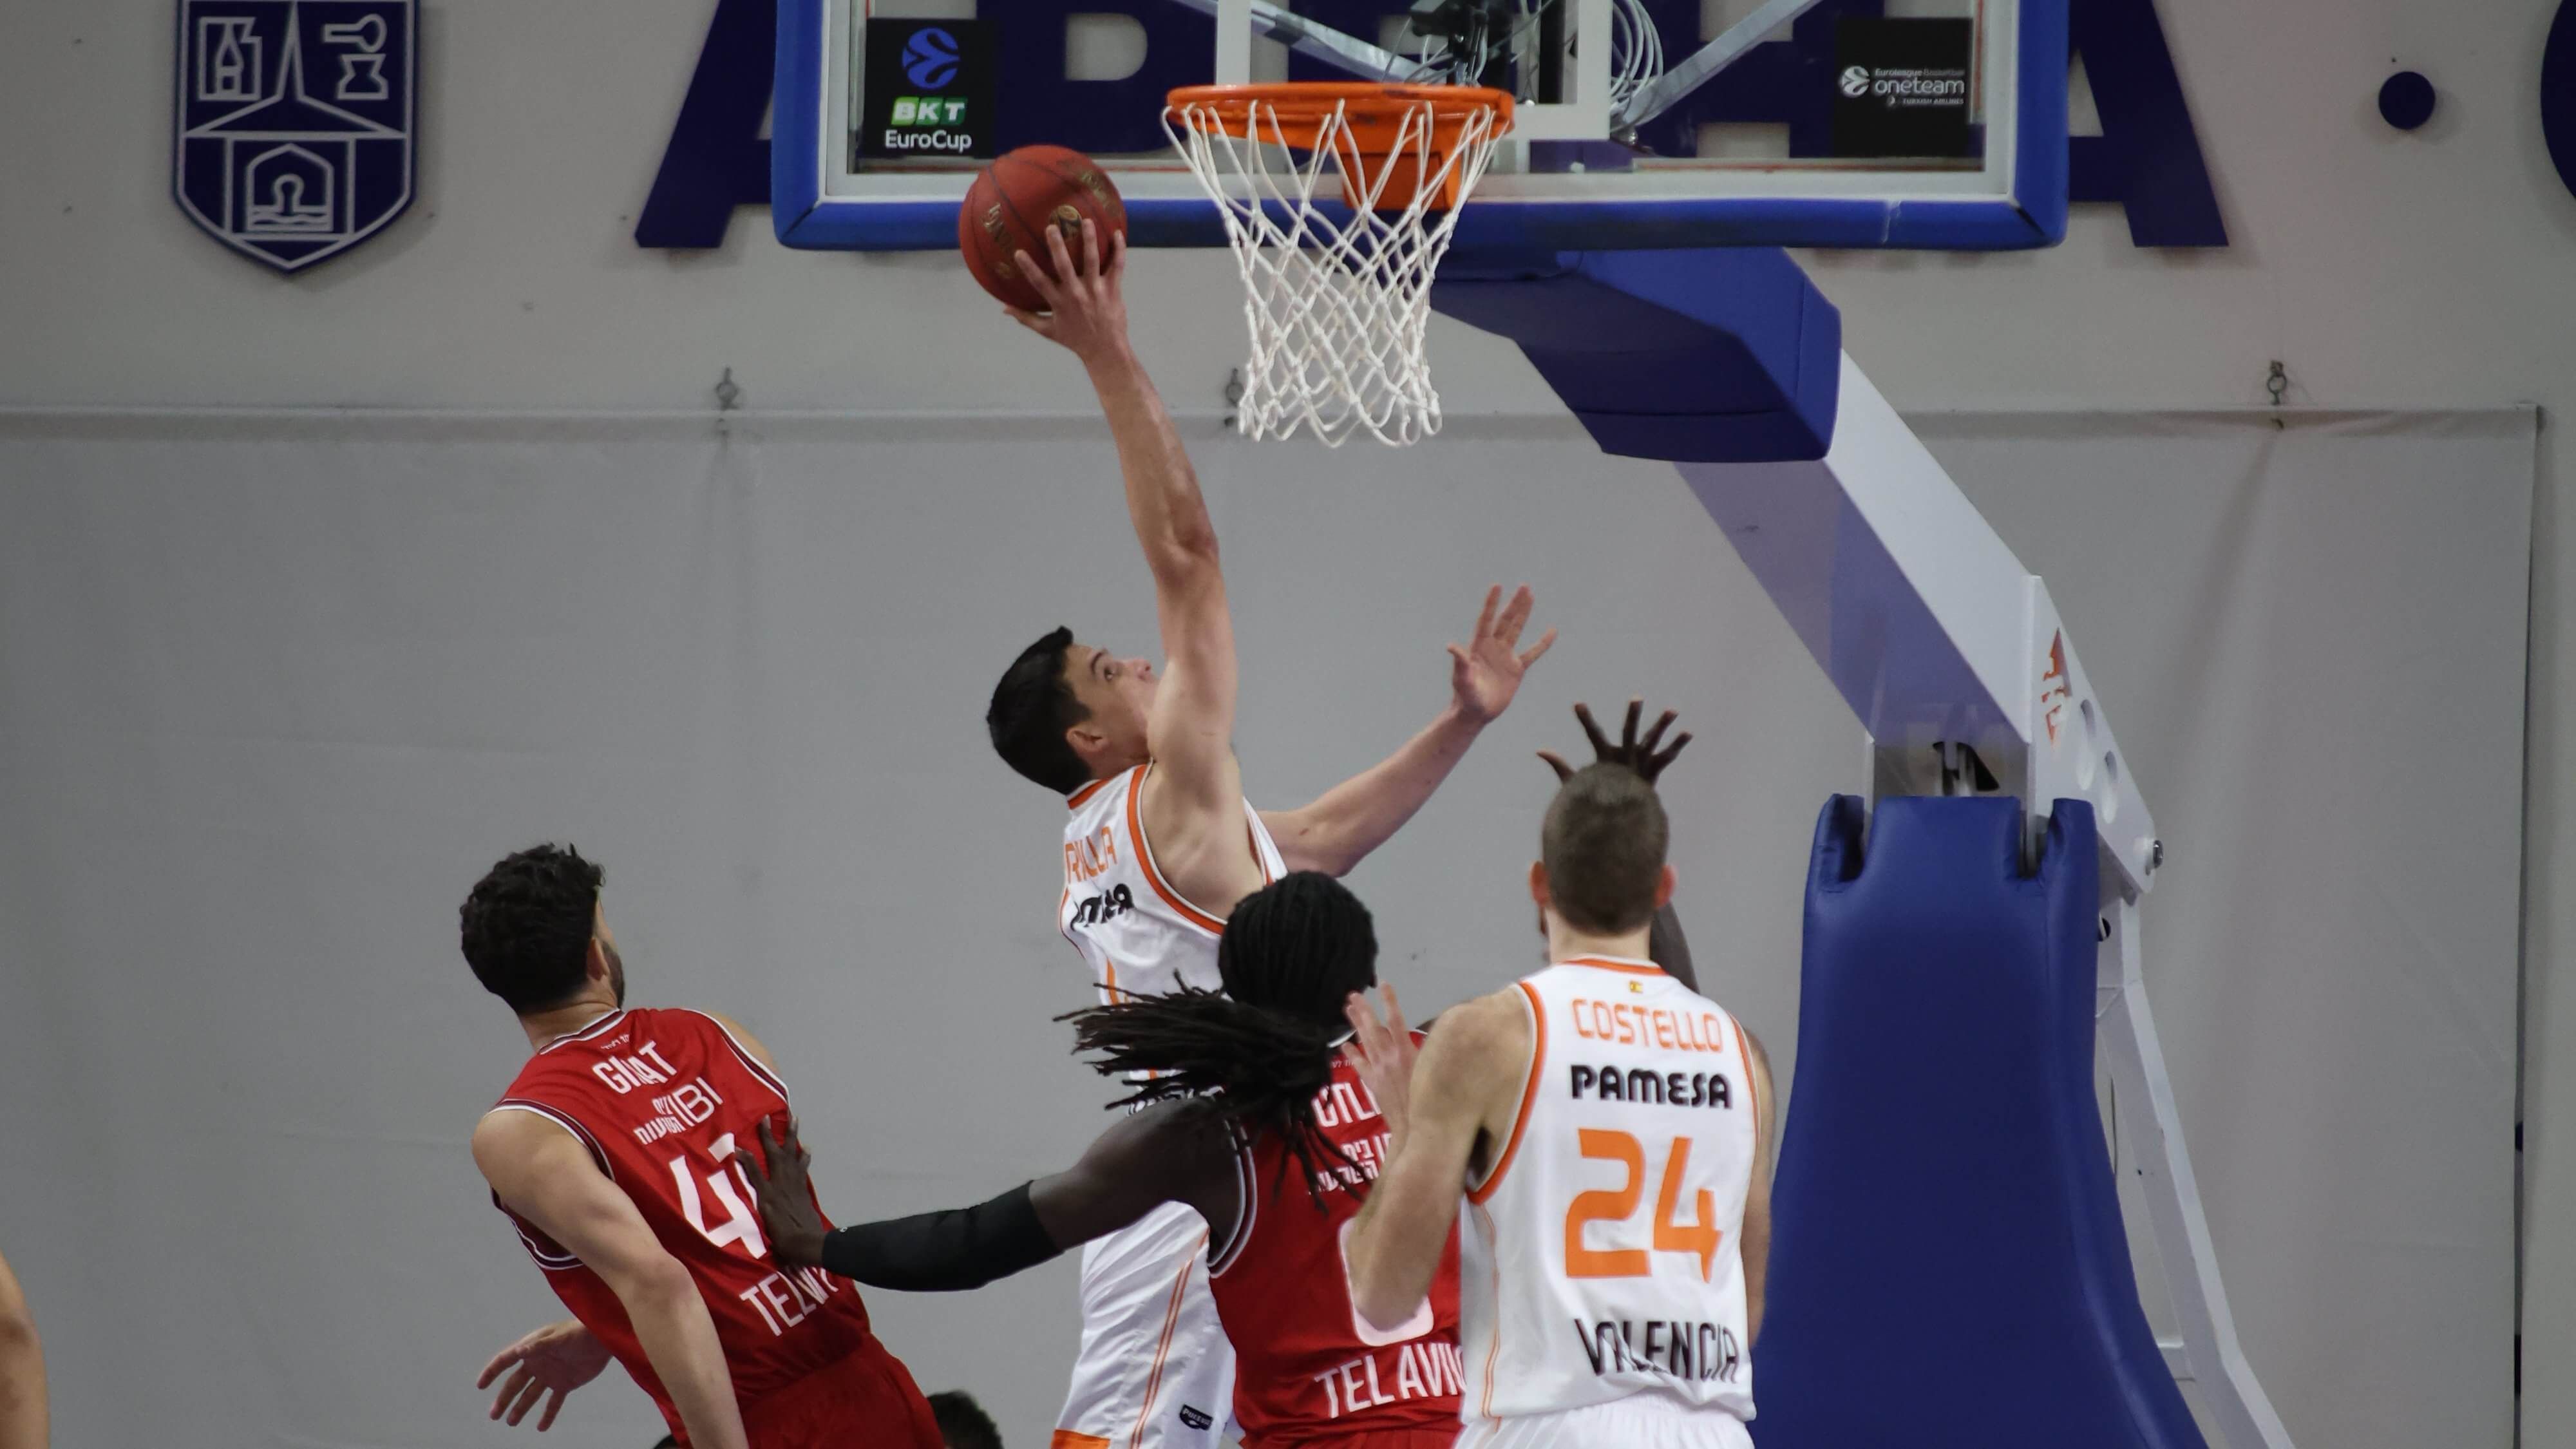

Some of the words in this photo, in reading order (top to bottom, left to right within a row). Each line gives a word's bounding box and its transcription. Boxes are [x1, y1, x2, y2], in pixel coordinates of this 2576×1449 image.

[1875, 77, 1965, 94] oneteam
[893, 102, 966, 121] BKT
[885, 129, 973, 154] EuroCup
[1571, 998, 1723, 1054] COSTELLO
[1570, 1064, 1733, 1110] PAMESA
[1564, 1127, 1724, 1285] 24
[1573, 1318, 1739, 1385] VALENCIA
[1313, 1354, 1396, 1419] TEL
